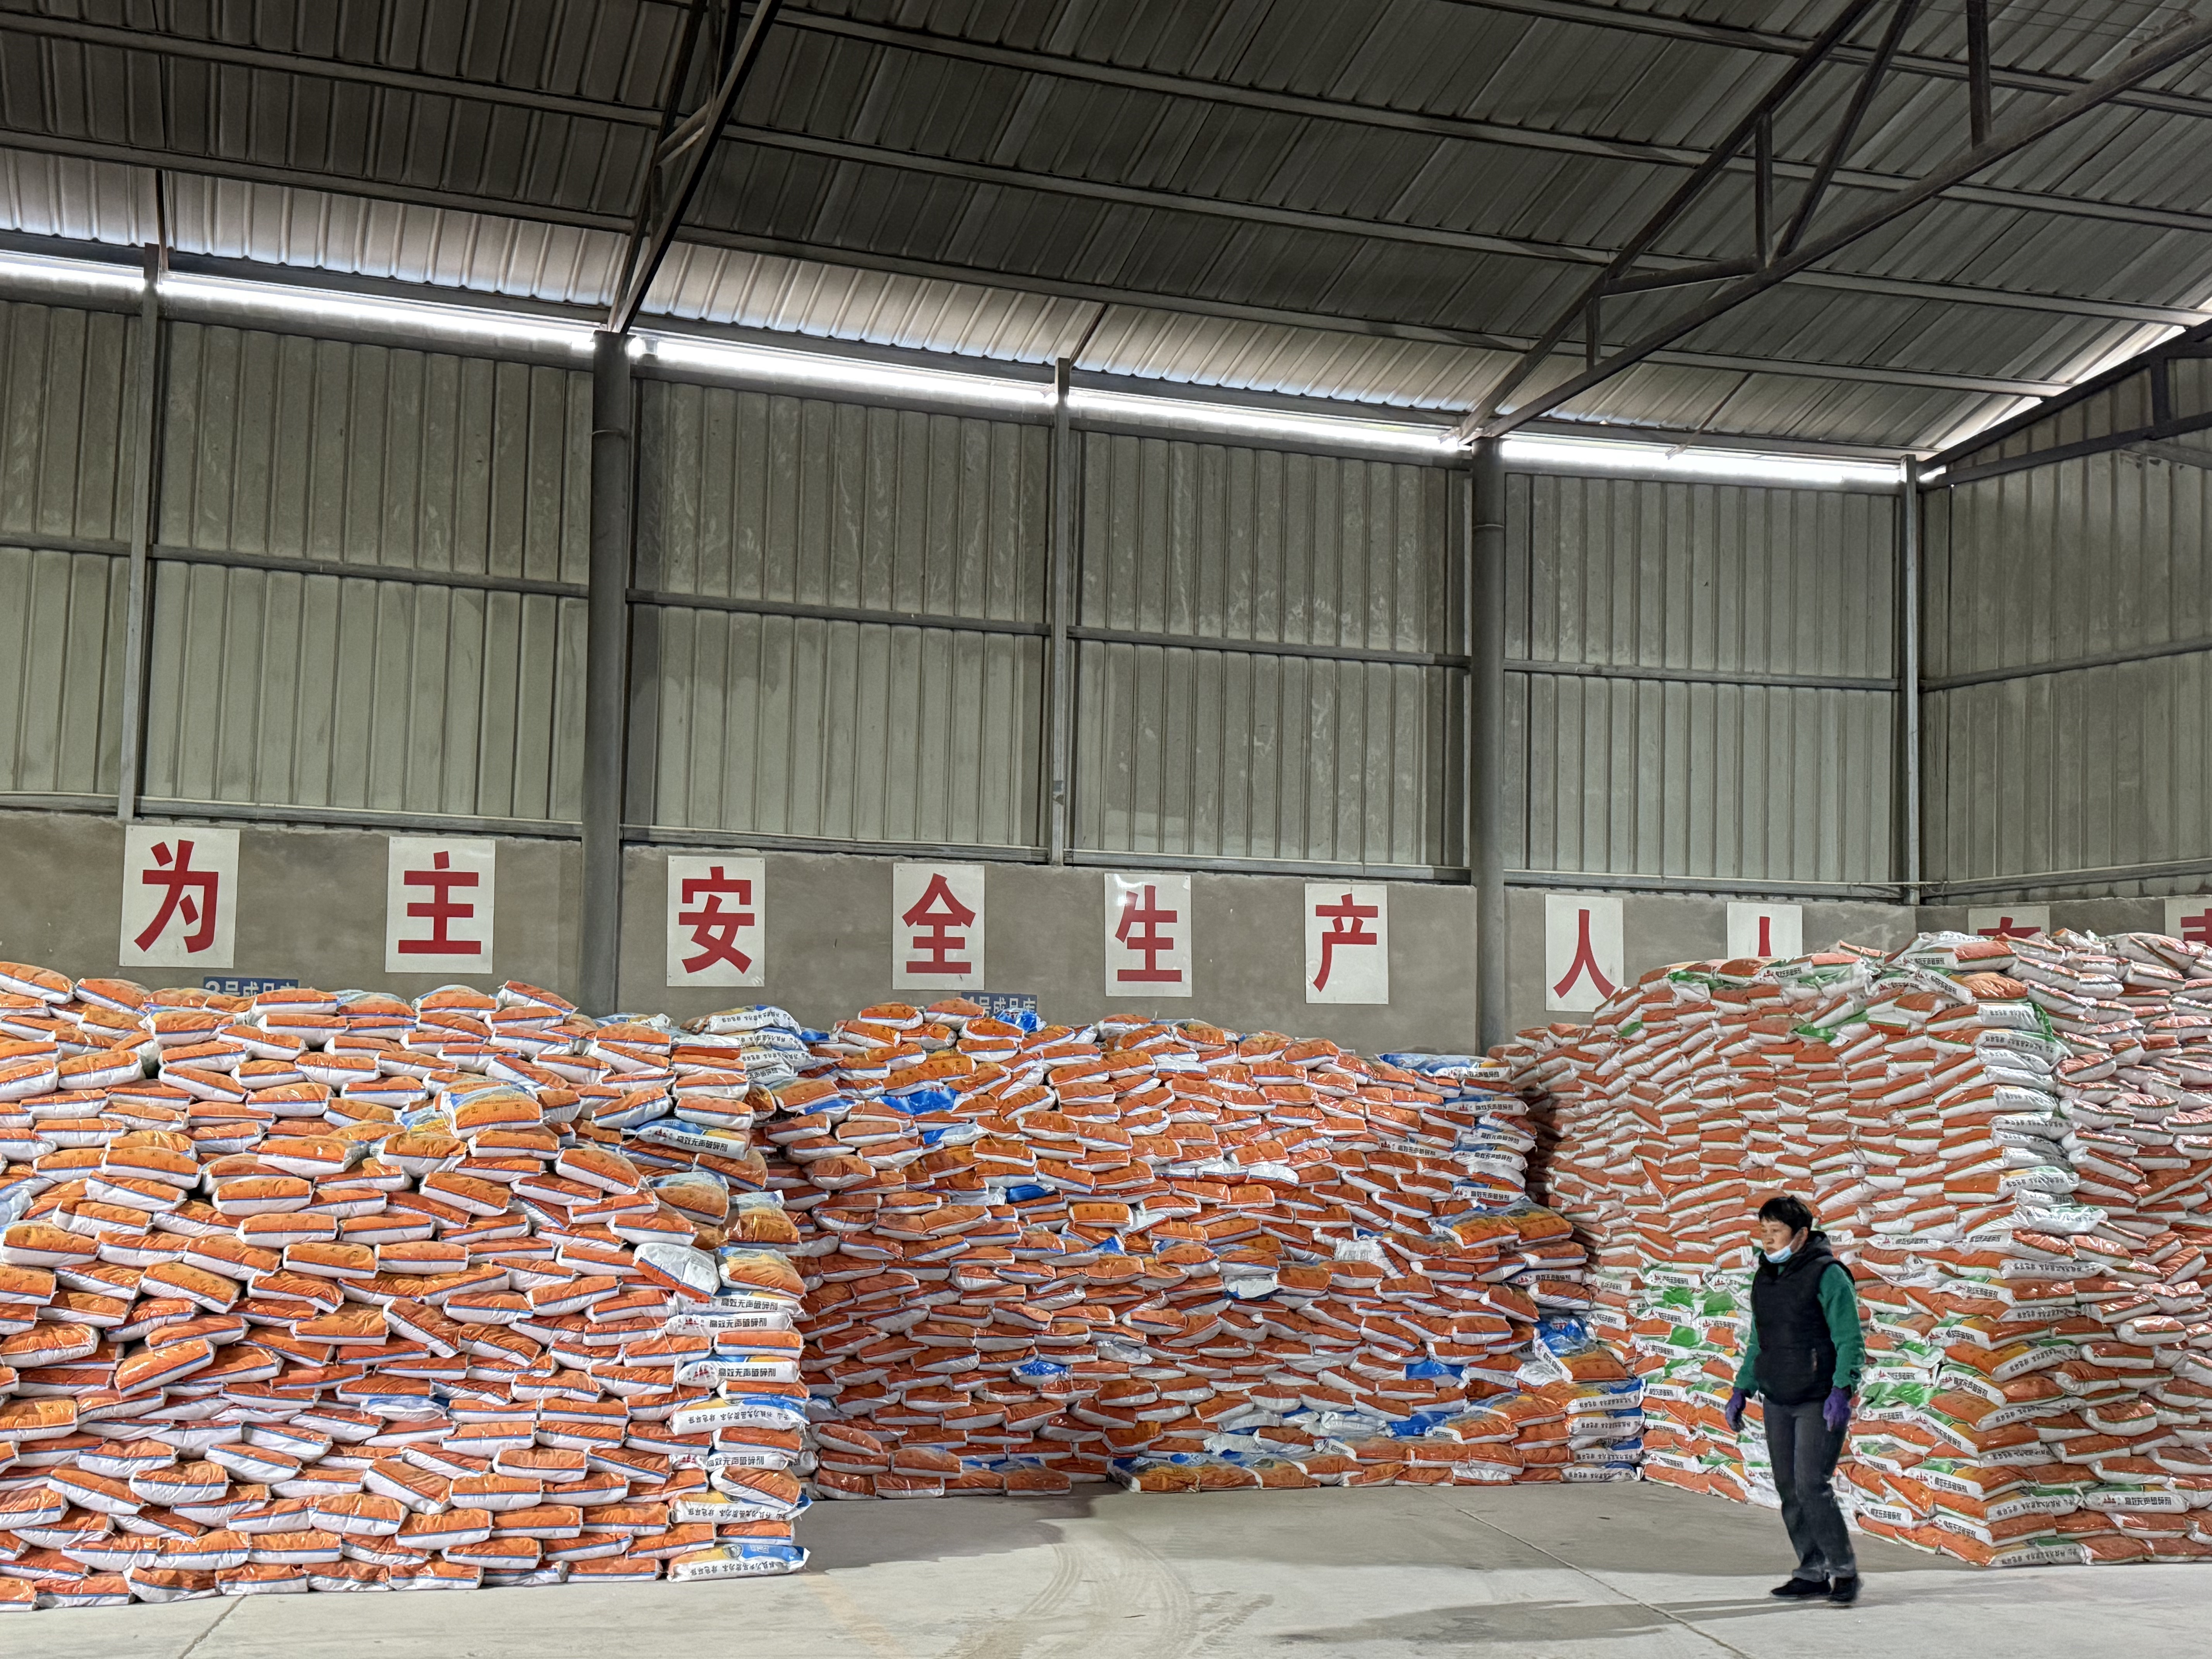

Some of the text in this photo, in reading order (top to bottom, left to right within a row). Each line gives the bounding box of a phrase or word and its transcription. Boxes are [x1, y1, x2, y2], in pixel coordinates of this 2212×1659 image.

[721, 1298, 778, 1311] 高效无声破碎剂
[709, 1318, 768, 1328] 高效无声破碎剂
[718, 1367, 776, 1377] 高效无声破碎剂
